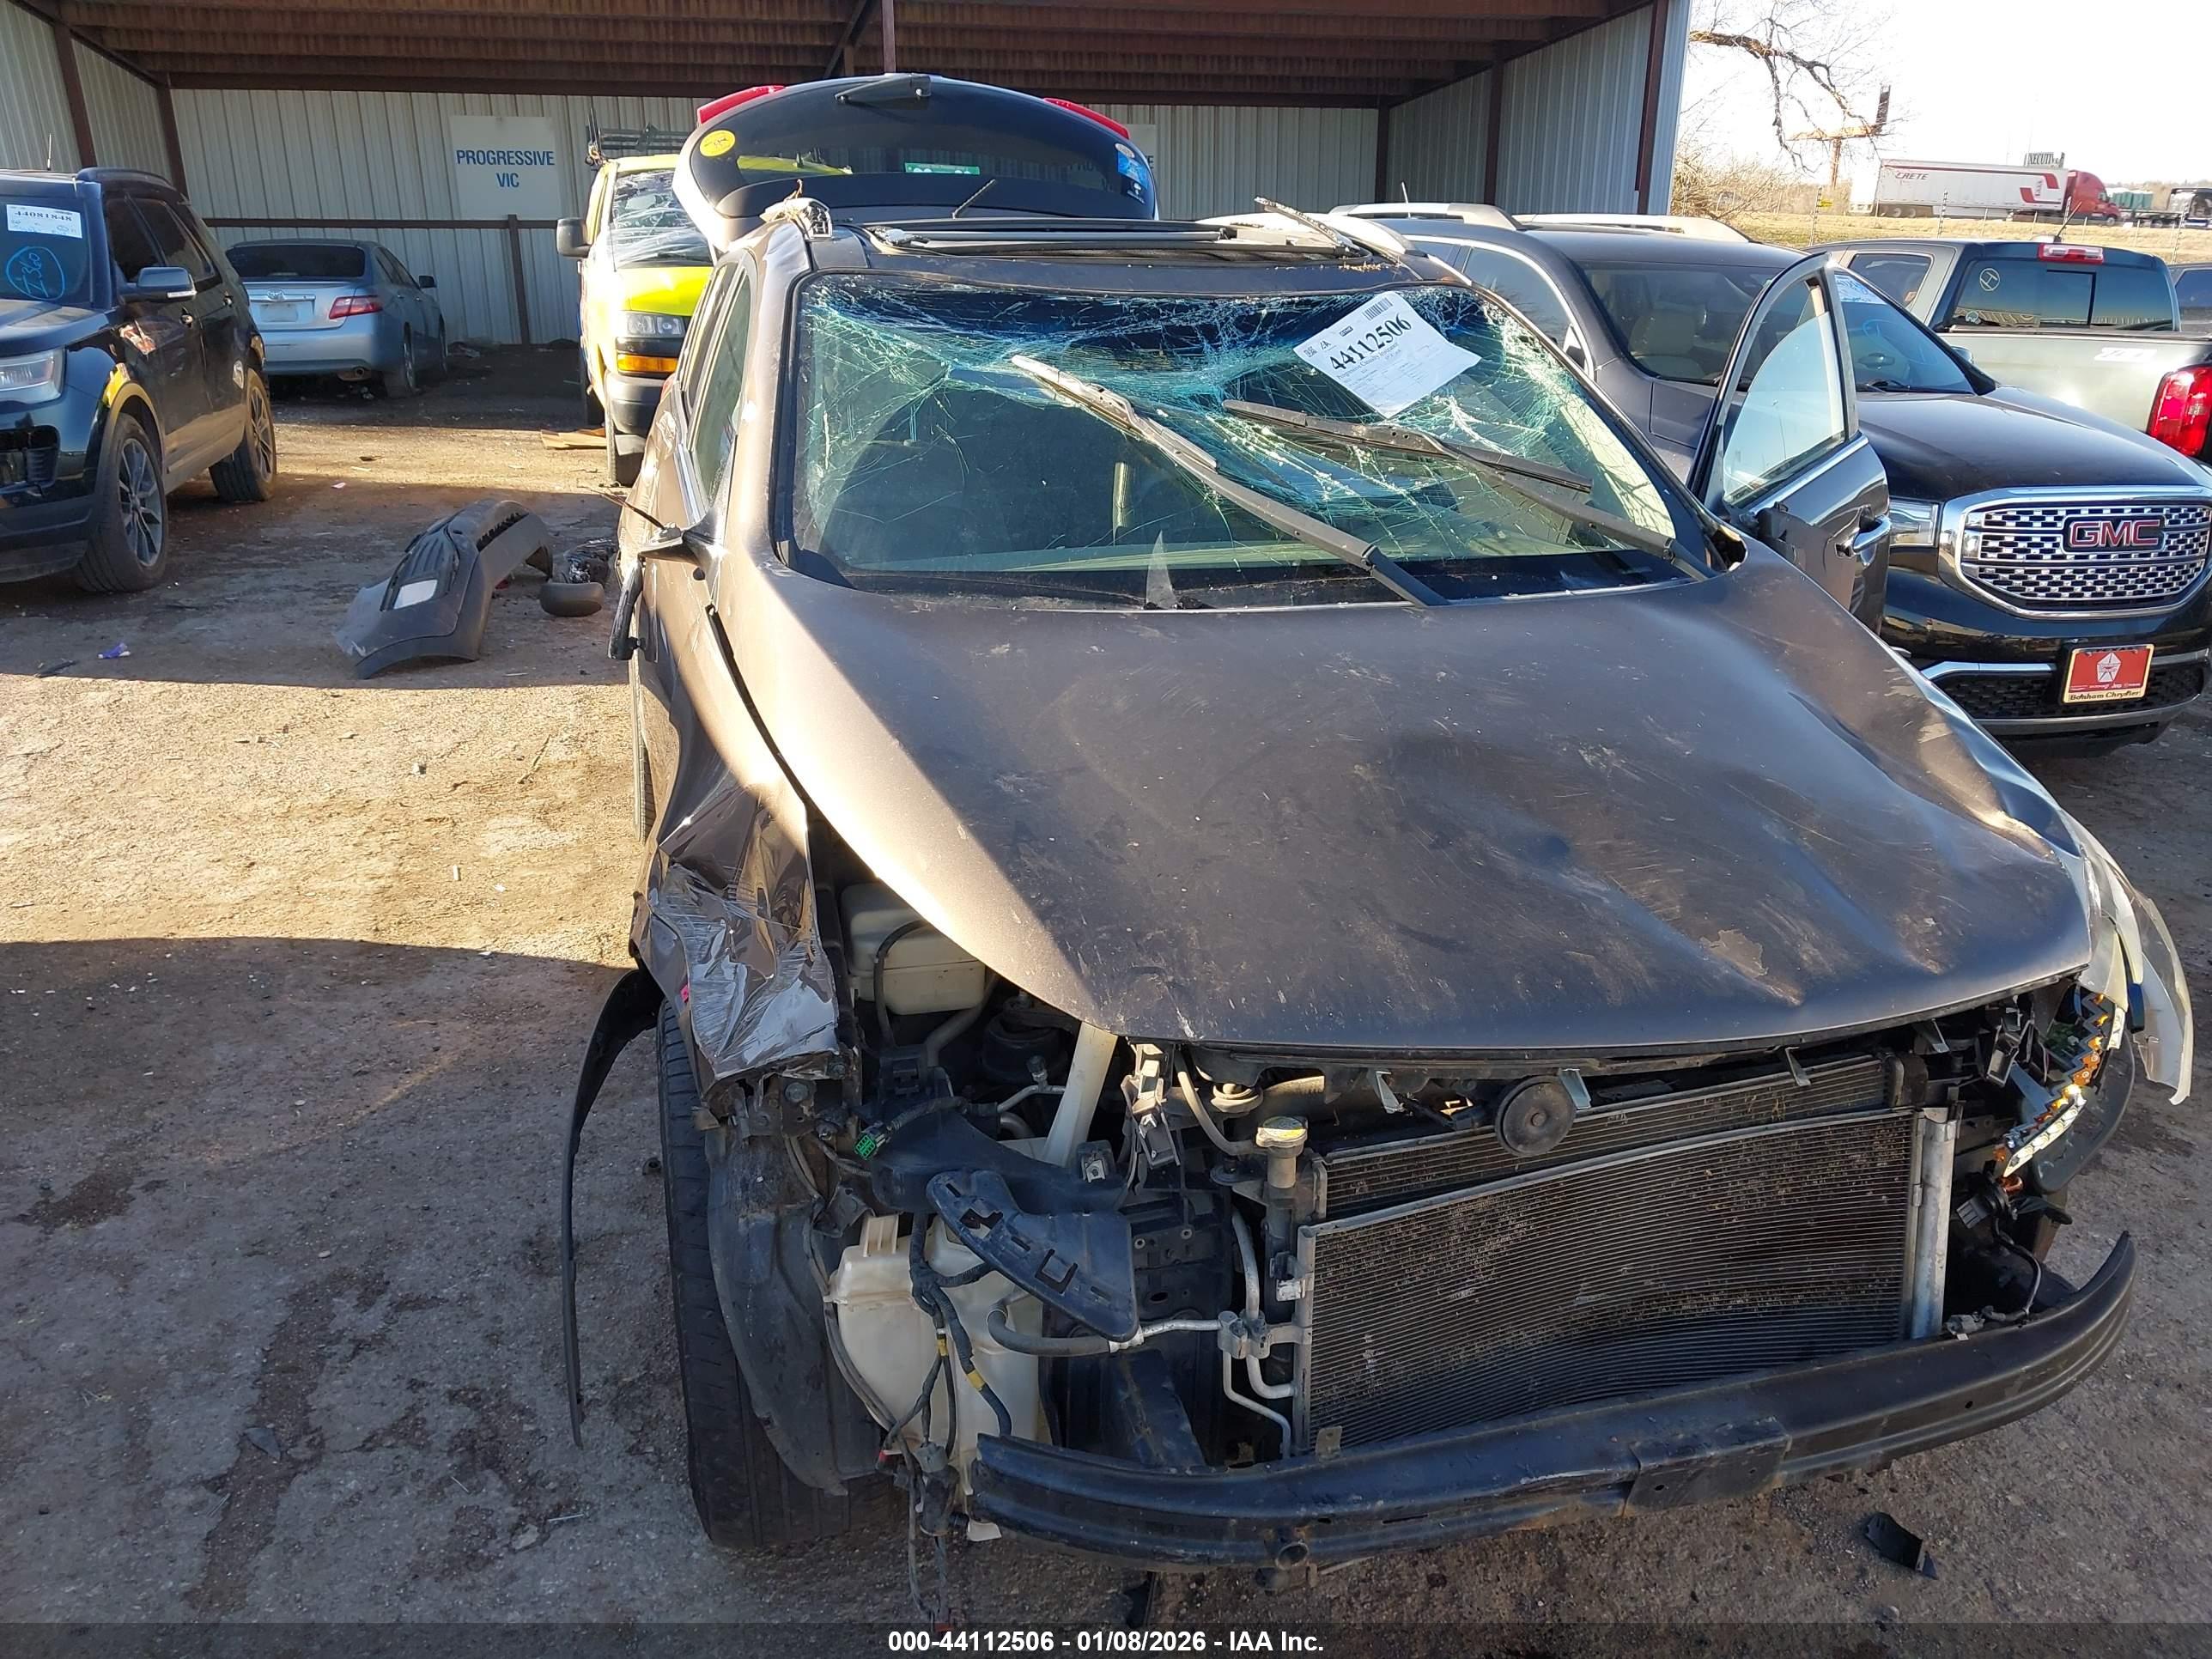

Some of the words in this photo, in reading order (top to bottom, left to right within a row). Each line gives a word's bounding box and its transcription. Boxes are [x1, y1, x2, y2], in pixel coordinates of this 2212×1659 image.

[456, 149, 555, 166] PROGRESSIVE
[495, 172, 520, 188] VIC
[1329, 313, 1413, 371] 44112506
[2069, 520, 2160, 547] GMC
